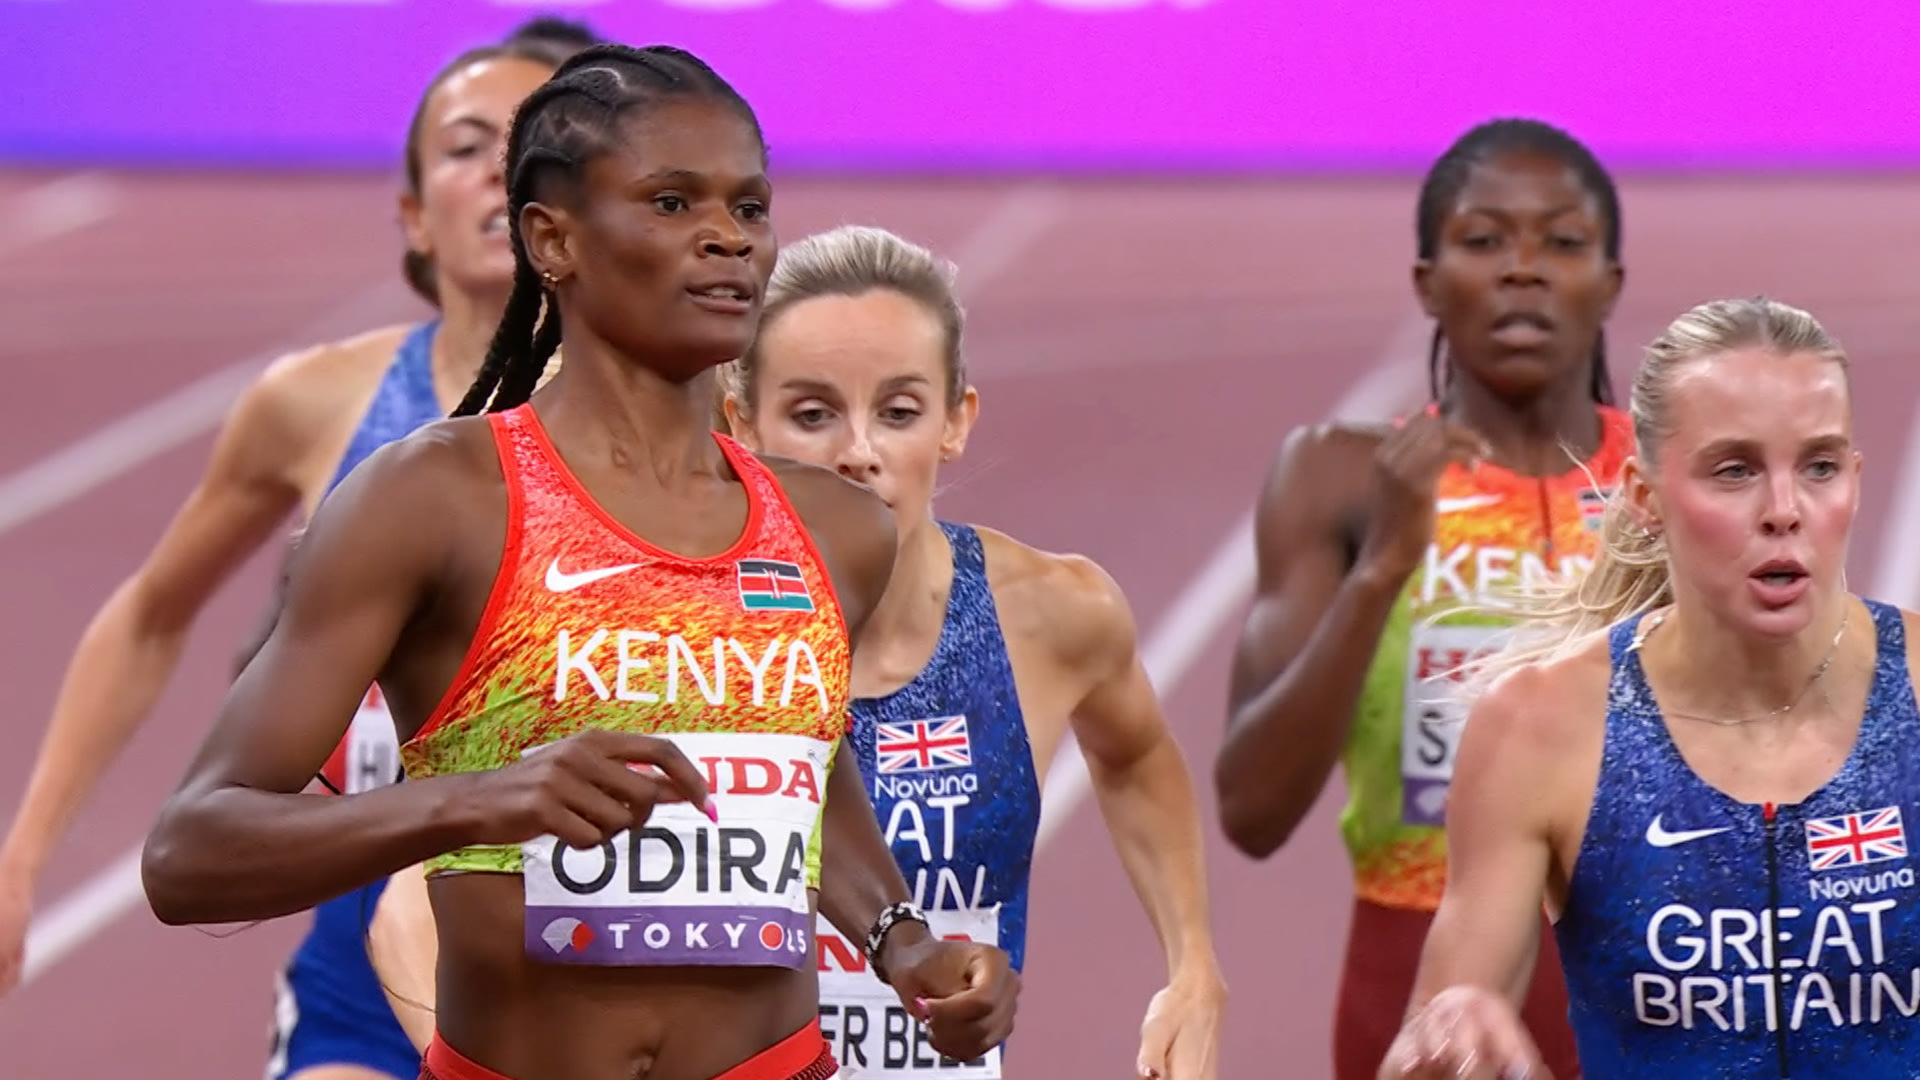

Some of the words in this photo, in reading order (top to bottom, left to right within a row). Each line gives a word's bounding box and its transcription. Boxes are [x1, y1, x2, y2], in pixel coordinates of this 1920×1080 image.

[555, 629, 829, 713] KENYA
[874, 773, 978, 799] Novuna
[551, 826, 805, 895] ODIRA
[1808, 868, 1914, 900] Novuna
[1646, 899, 1897, 971] GREAT
[1633, 968, 1920, 1032] BRITAIN
